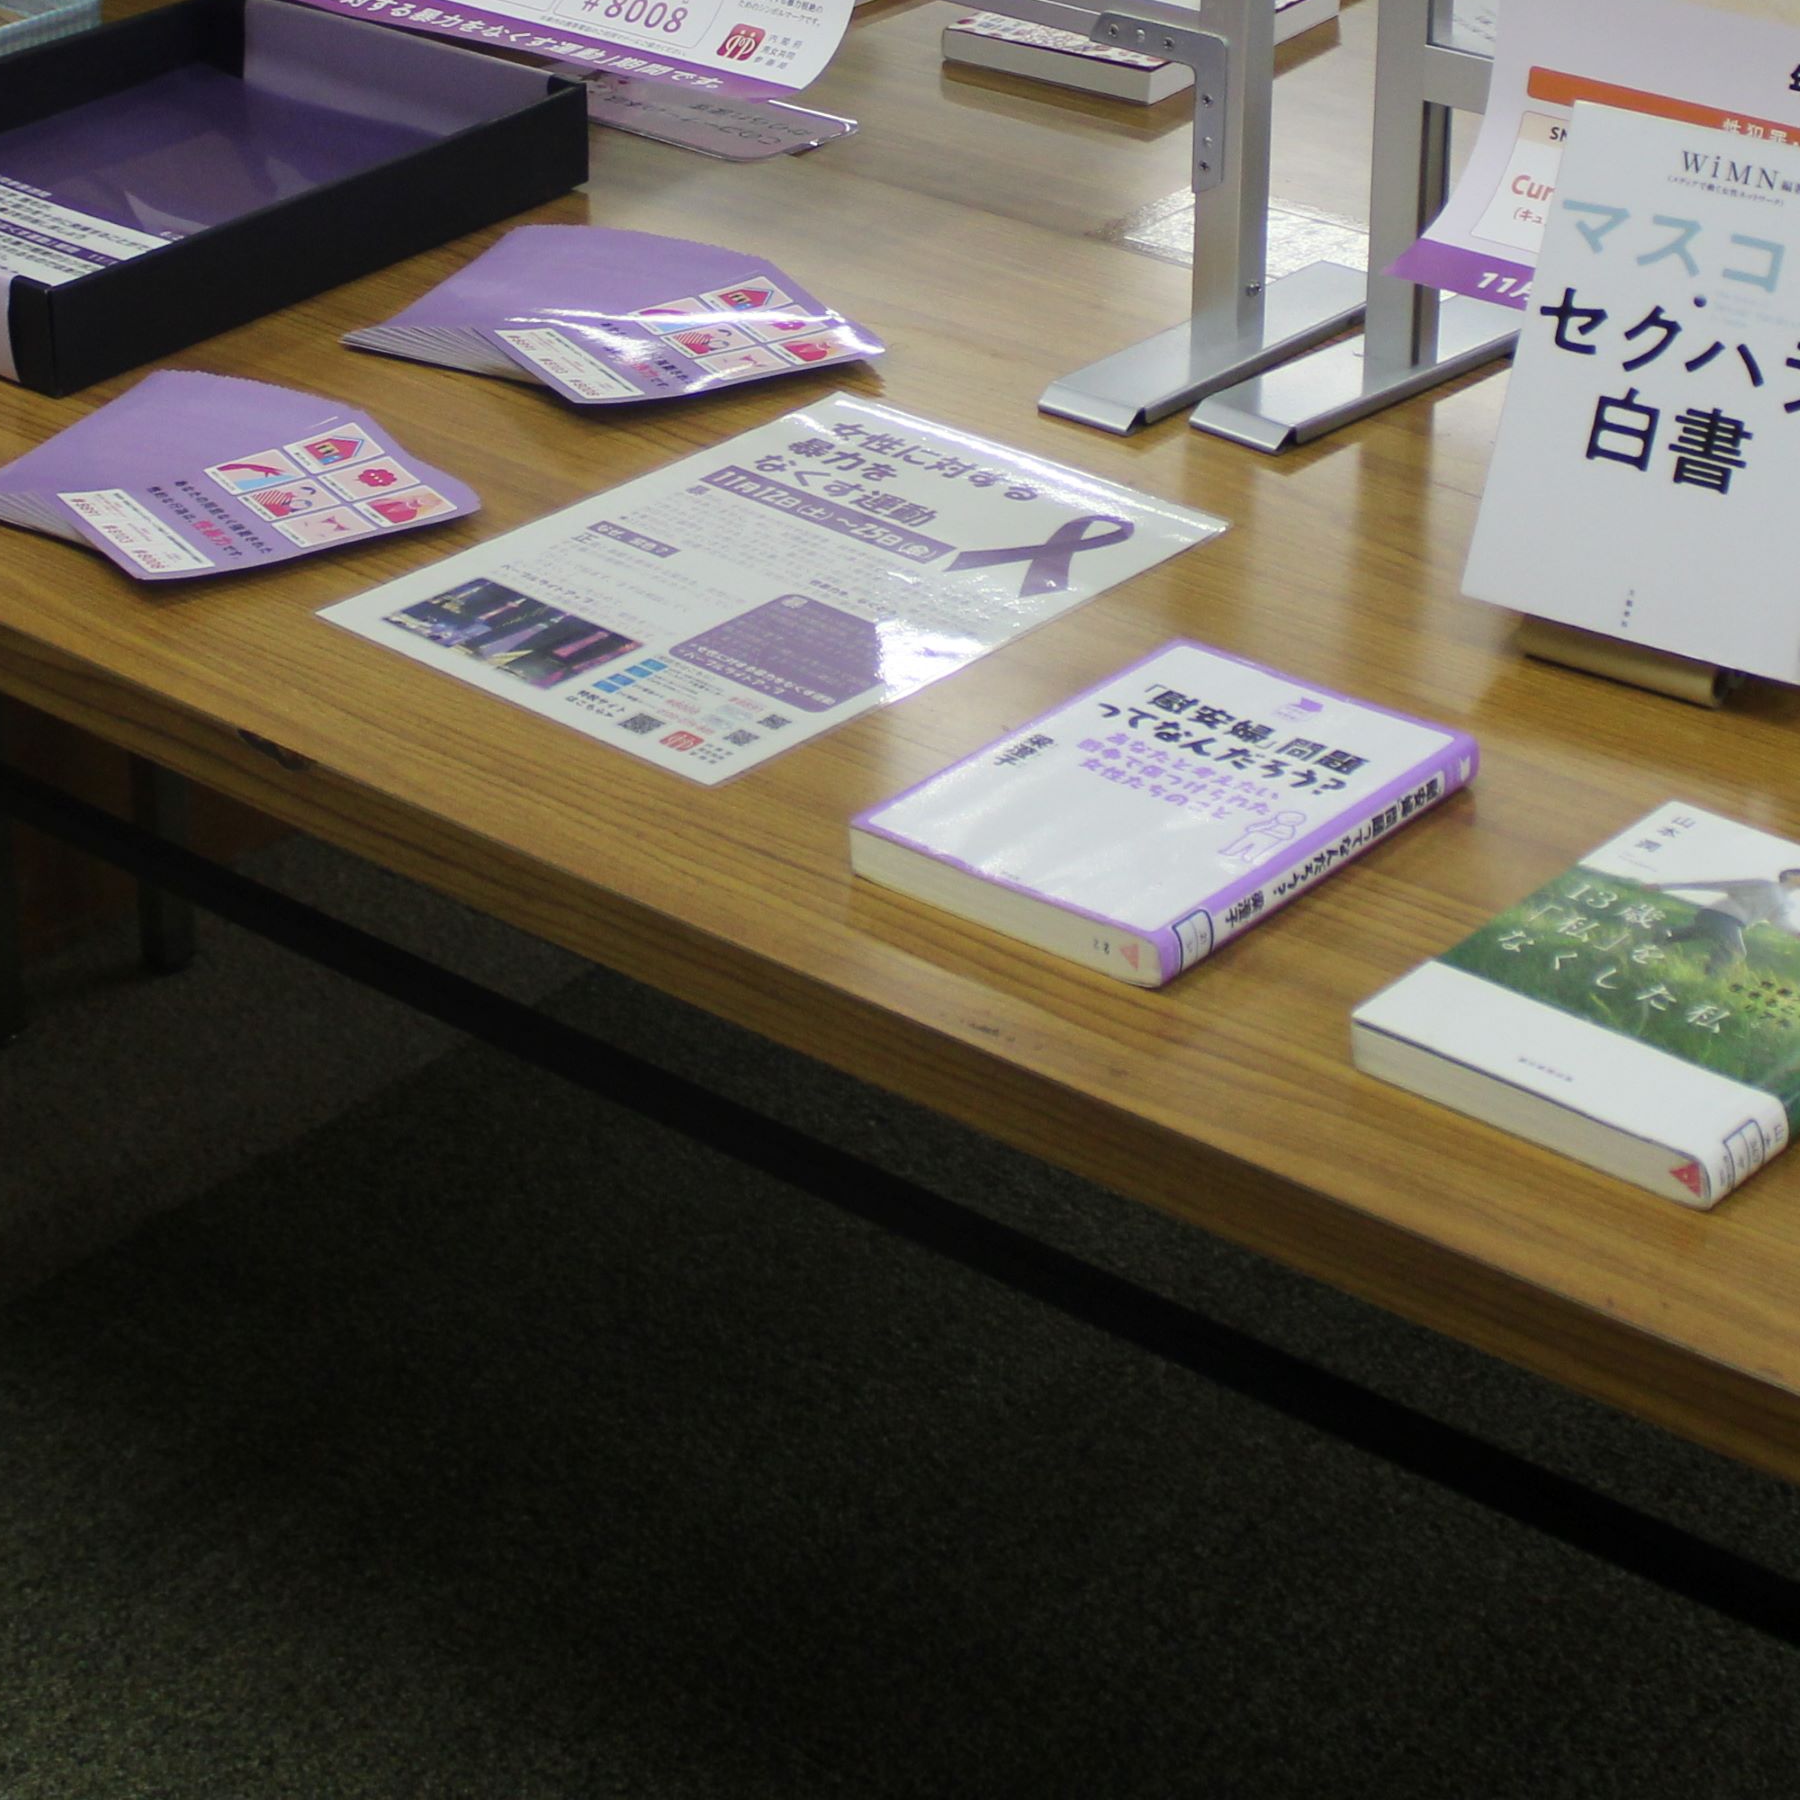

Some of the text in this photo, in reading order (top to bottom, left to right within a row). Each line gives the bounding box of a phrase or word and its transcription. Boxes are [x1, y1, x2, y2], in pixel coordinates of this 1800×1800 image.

[1511, 174, 1556, 201] Cur
[1681, 150, 1781, 192] WiMN
[787, 436, 899, 483] 暴力を
[831, 422, 1040, 502] 女性に対する
[1585, 387, 1754, 496] 白書
[754, 453, 940, 529] なくす運動
[1098, 702, 1348, 796] ってなんだろう?
